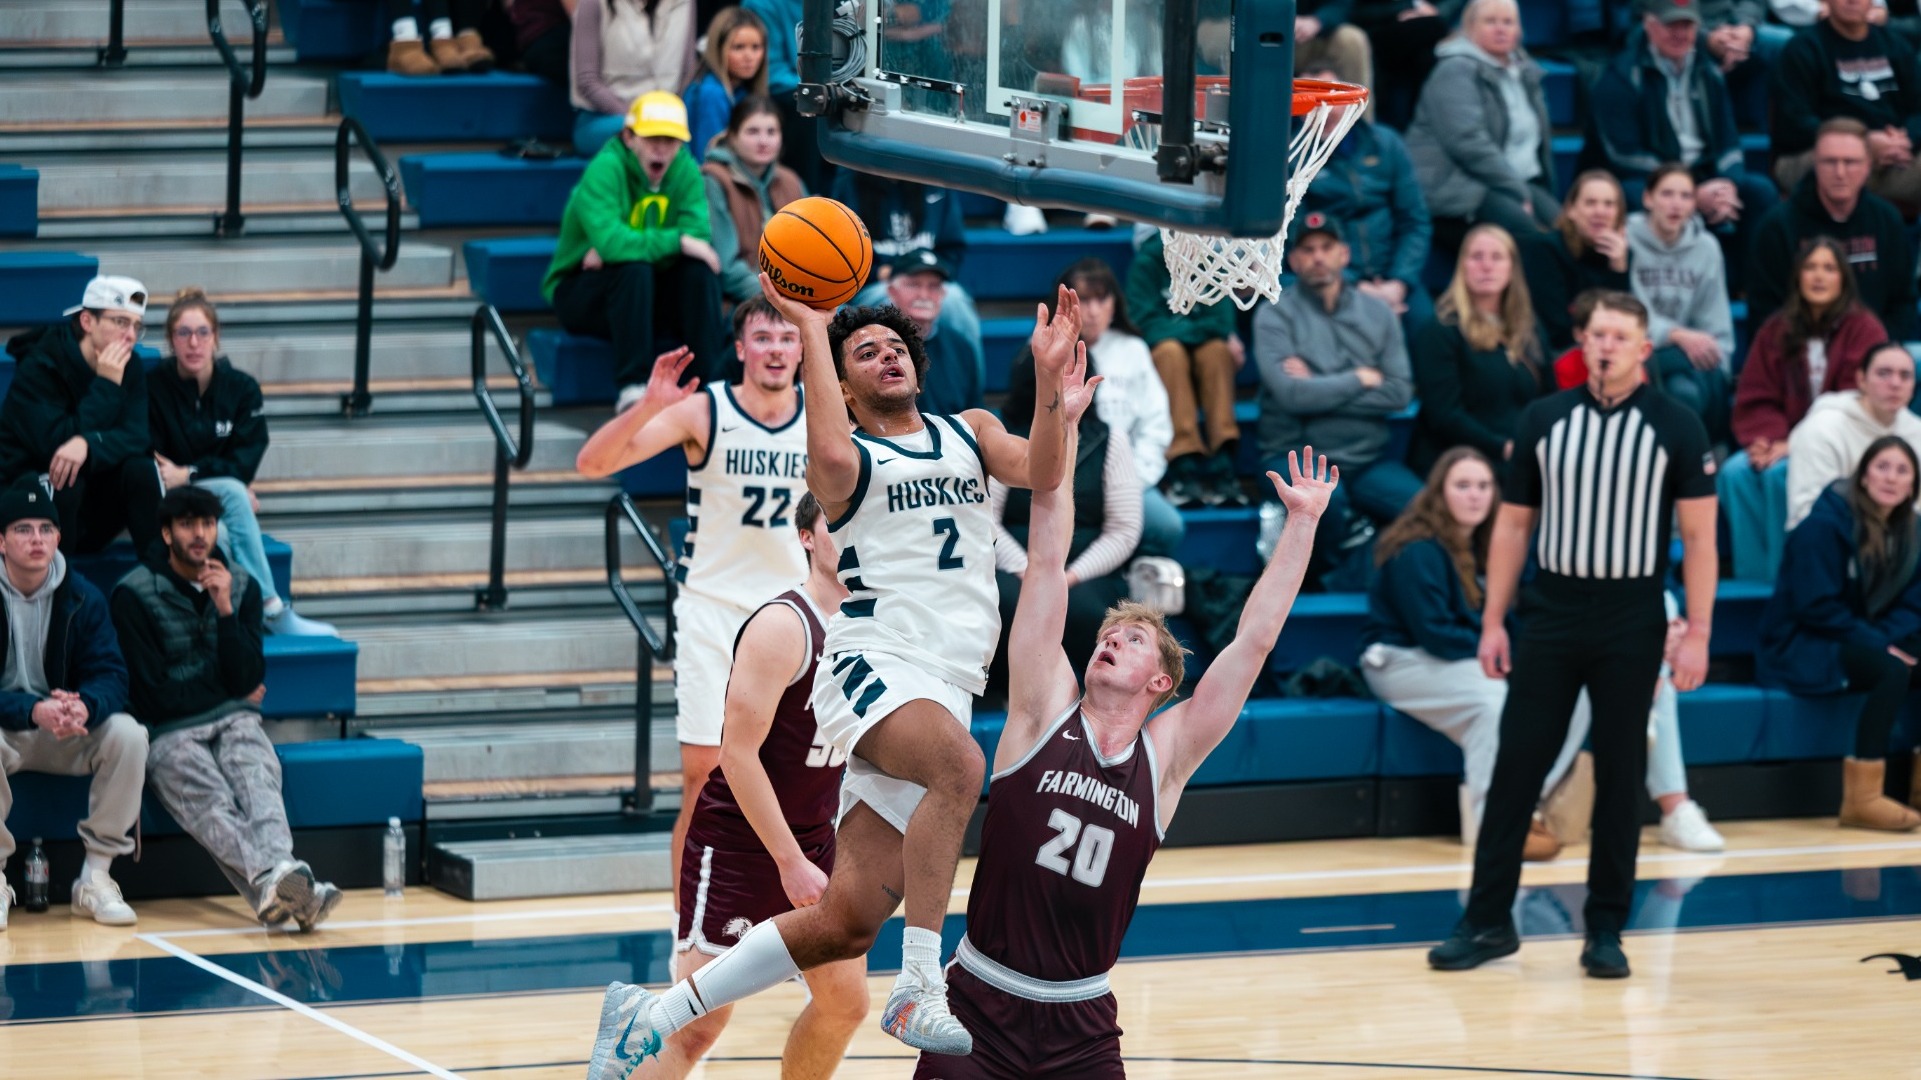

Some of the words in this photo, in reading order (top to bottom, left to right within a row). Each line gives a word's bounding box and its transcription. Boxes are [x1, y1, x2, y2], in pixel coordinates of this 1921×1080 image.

[761, 246, 815, 297] Wilson
[741, 485, 791, 529] 22
[887, 477, 985, 513] HUSKIES
[932, 517, 965, 572] 2
[1036, 770, 1140, 830] FARMINGTON
[1035, 807, 1115, 888] 20
